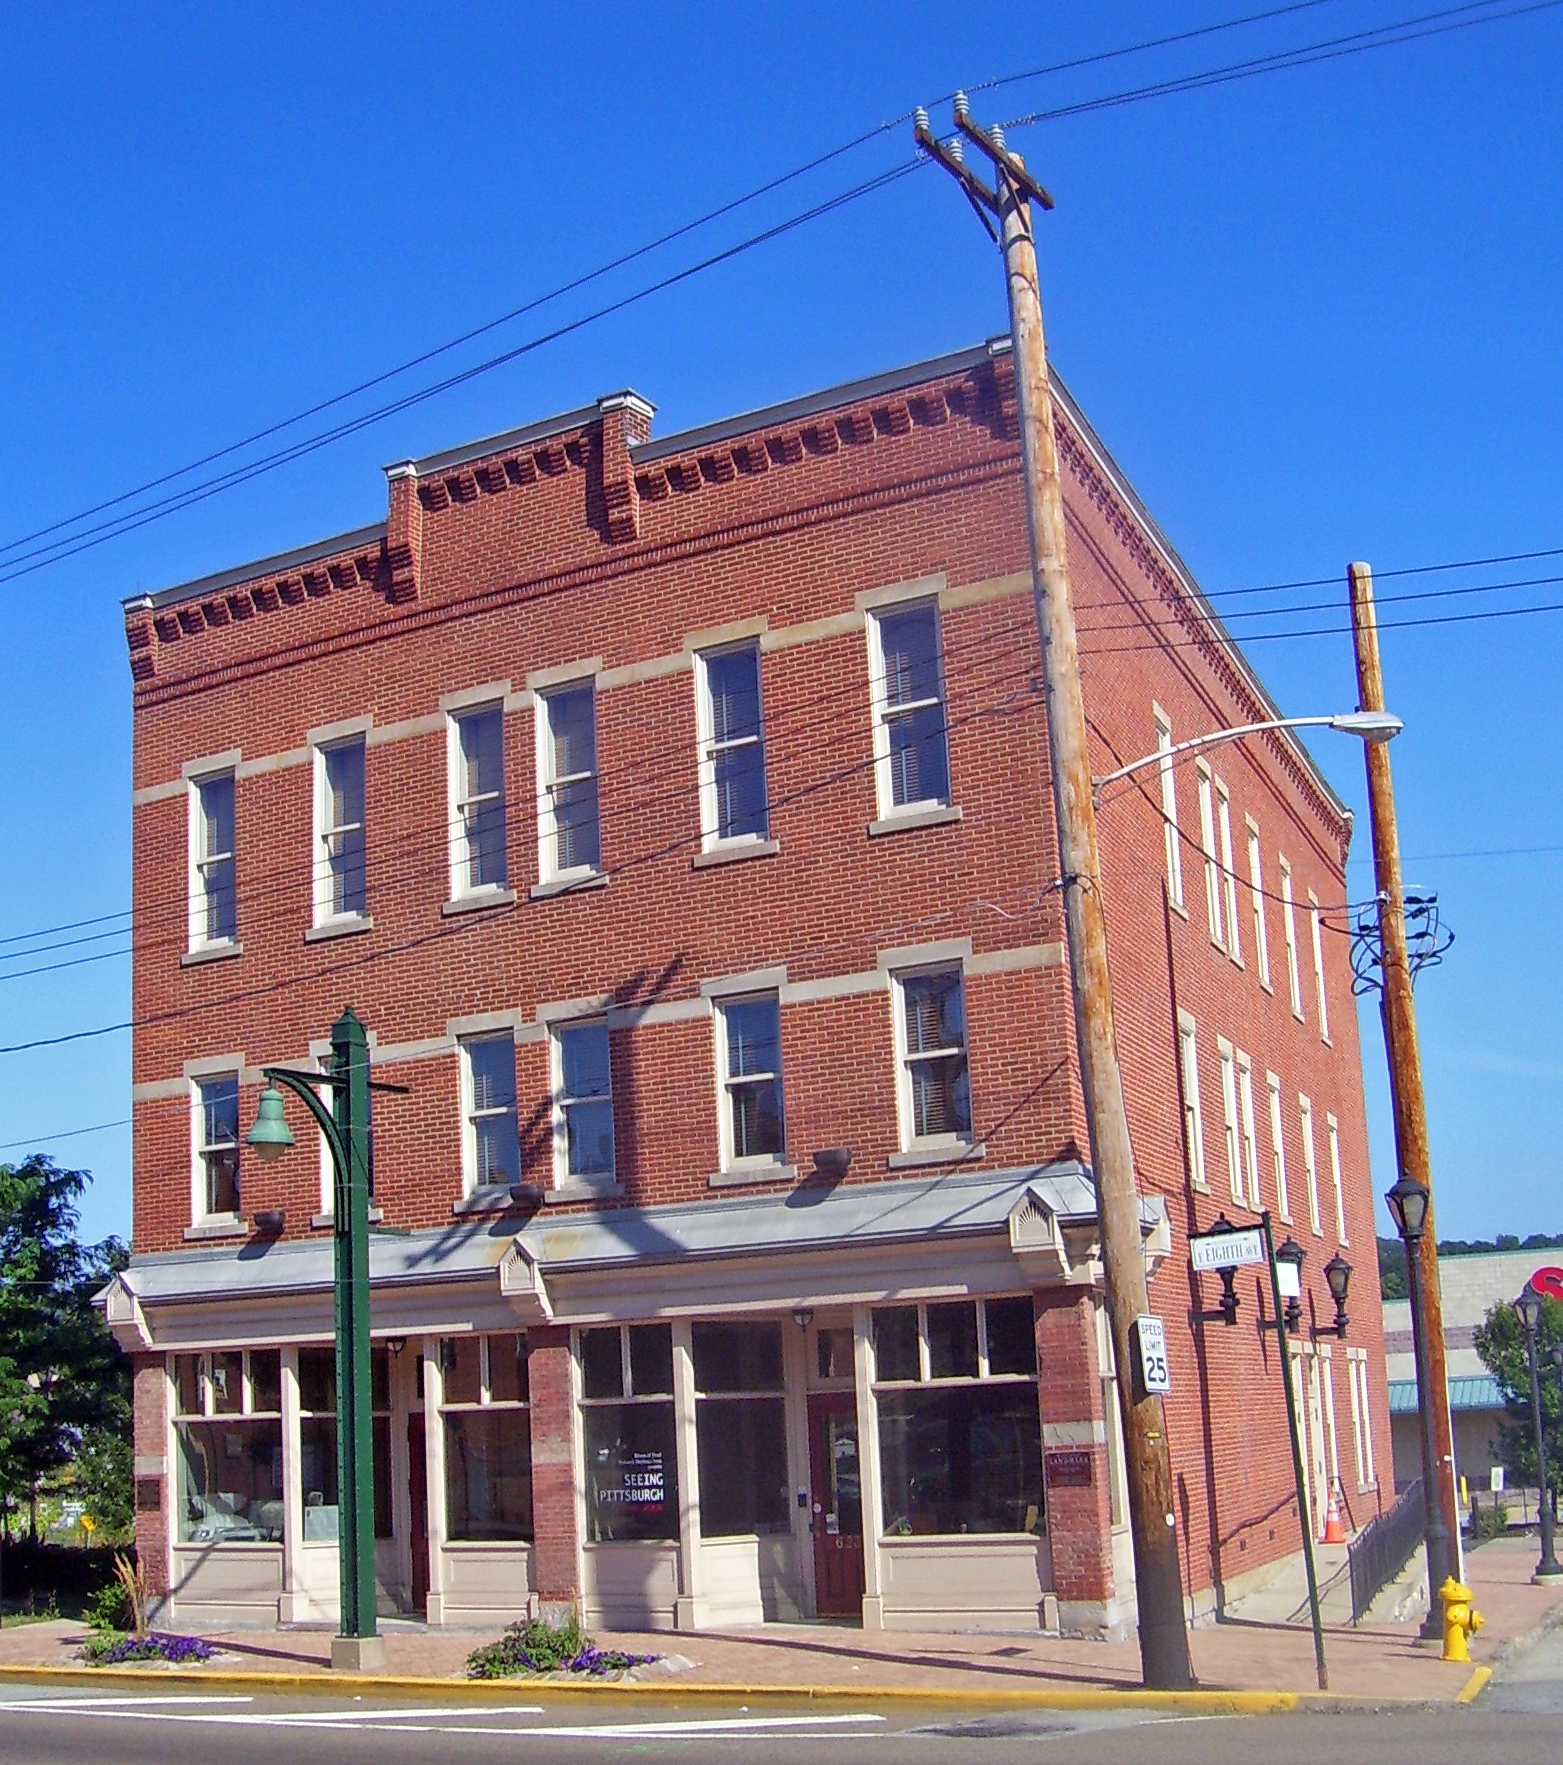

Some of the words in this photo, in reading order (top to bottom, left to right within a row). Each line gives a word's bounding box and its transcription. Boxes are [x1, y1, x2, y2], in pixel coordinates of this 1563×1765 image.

[1205, 1243, 1243, 1262] EIGHTH
[1141, 1323, 1162, 1336] SPEED
[1145, 1341, 1161, 1351] LIMIT
[1146, 1356, 1167, 1383] 25
[624, 1473, 664, 1486] SEEING
[600, 1488, 664, 1502] PITTSBURGH
